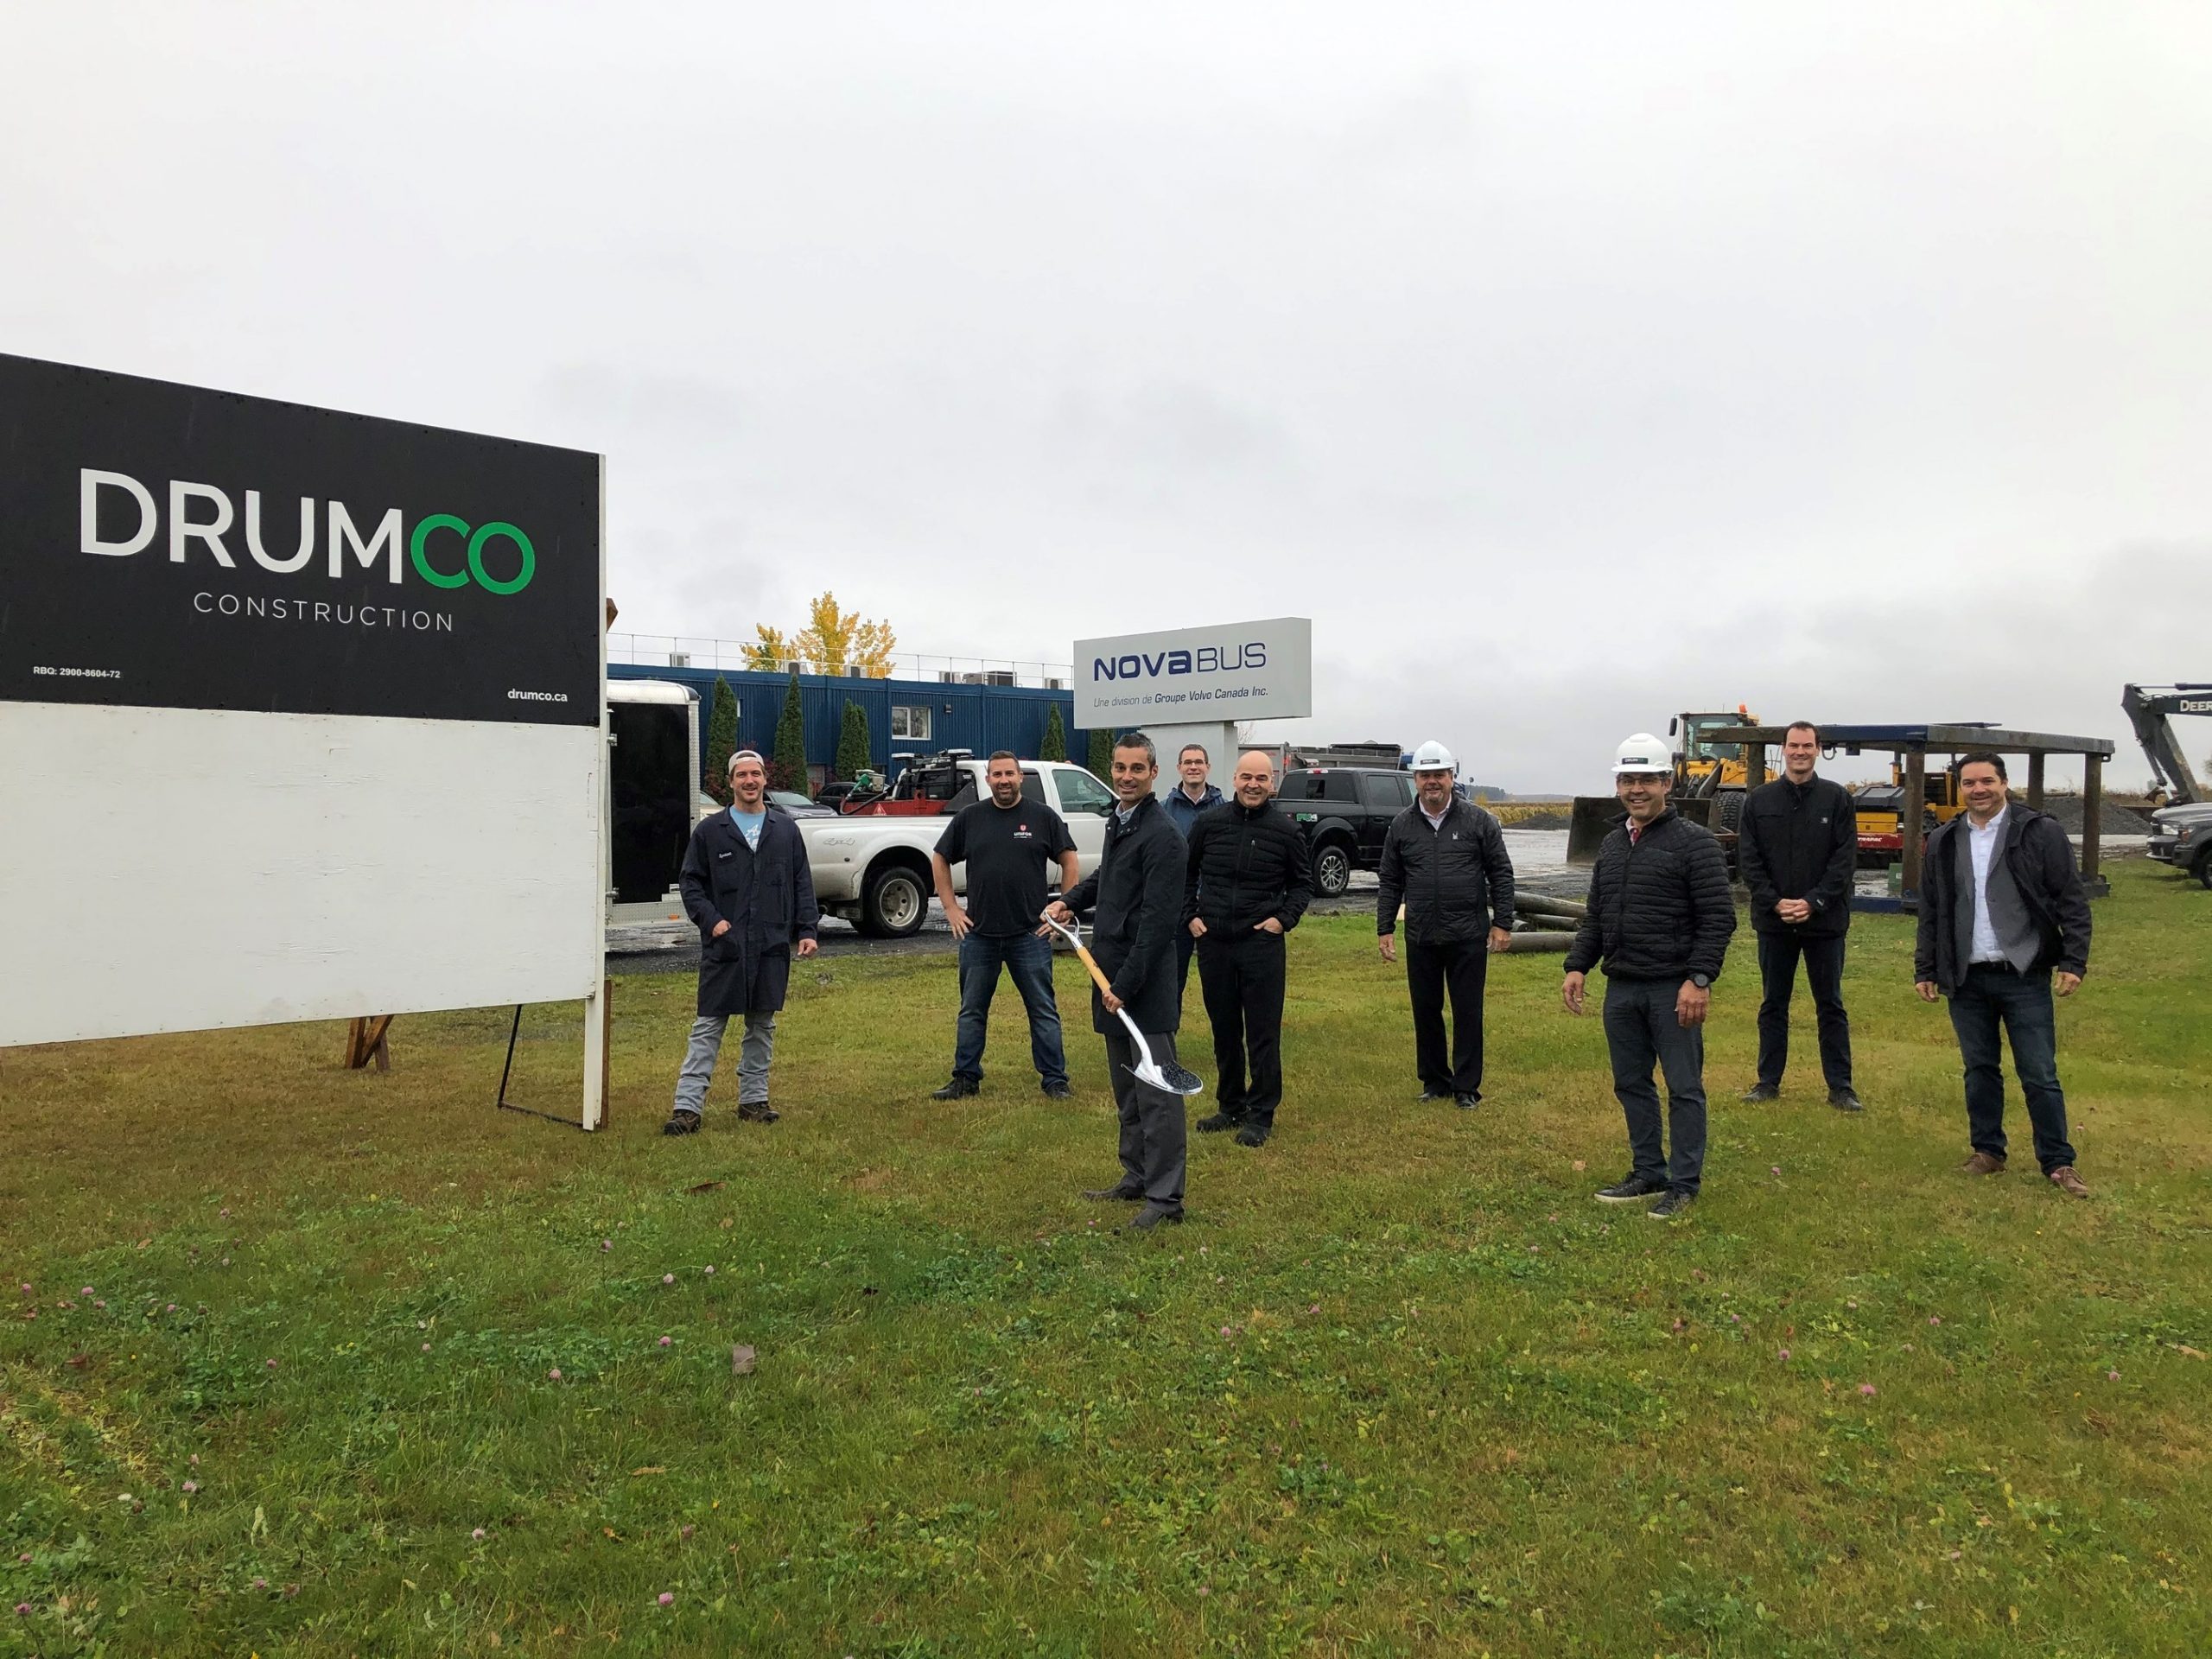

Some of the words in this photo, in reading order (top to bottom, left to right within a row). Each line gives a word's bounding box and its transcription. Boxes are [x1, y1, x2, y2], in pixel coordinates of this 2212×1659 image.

[80, 467, 536, 594] DRUMCO
[194, 592, 453, 632] CONSTRUCTION
[33, 666, 58, 676] RBQ:
[60, 667, 121, 678] 2900-8604-72
[507, 688, 569, 702] drumco.ca
[1093, 697, 1109, 708] Une
[1111, 696, 1140, 707] division
[1141, 694, 1153, 705] de
[1154, 692, 1186, 705] Groupe
[1189, 690, 1212, 702] Volvo
[1214, 687, 1249, 699] Canada
[1252, 686, 1268, 696] Inc.
